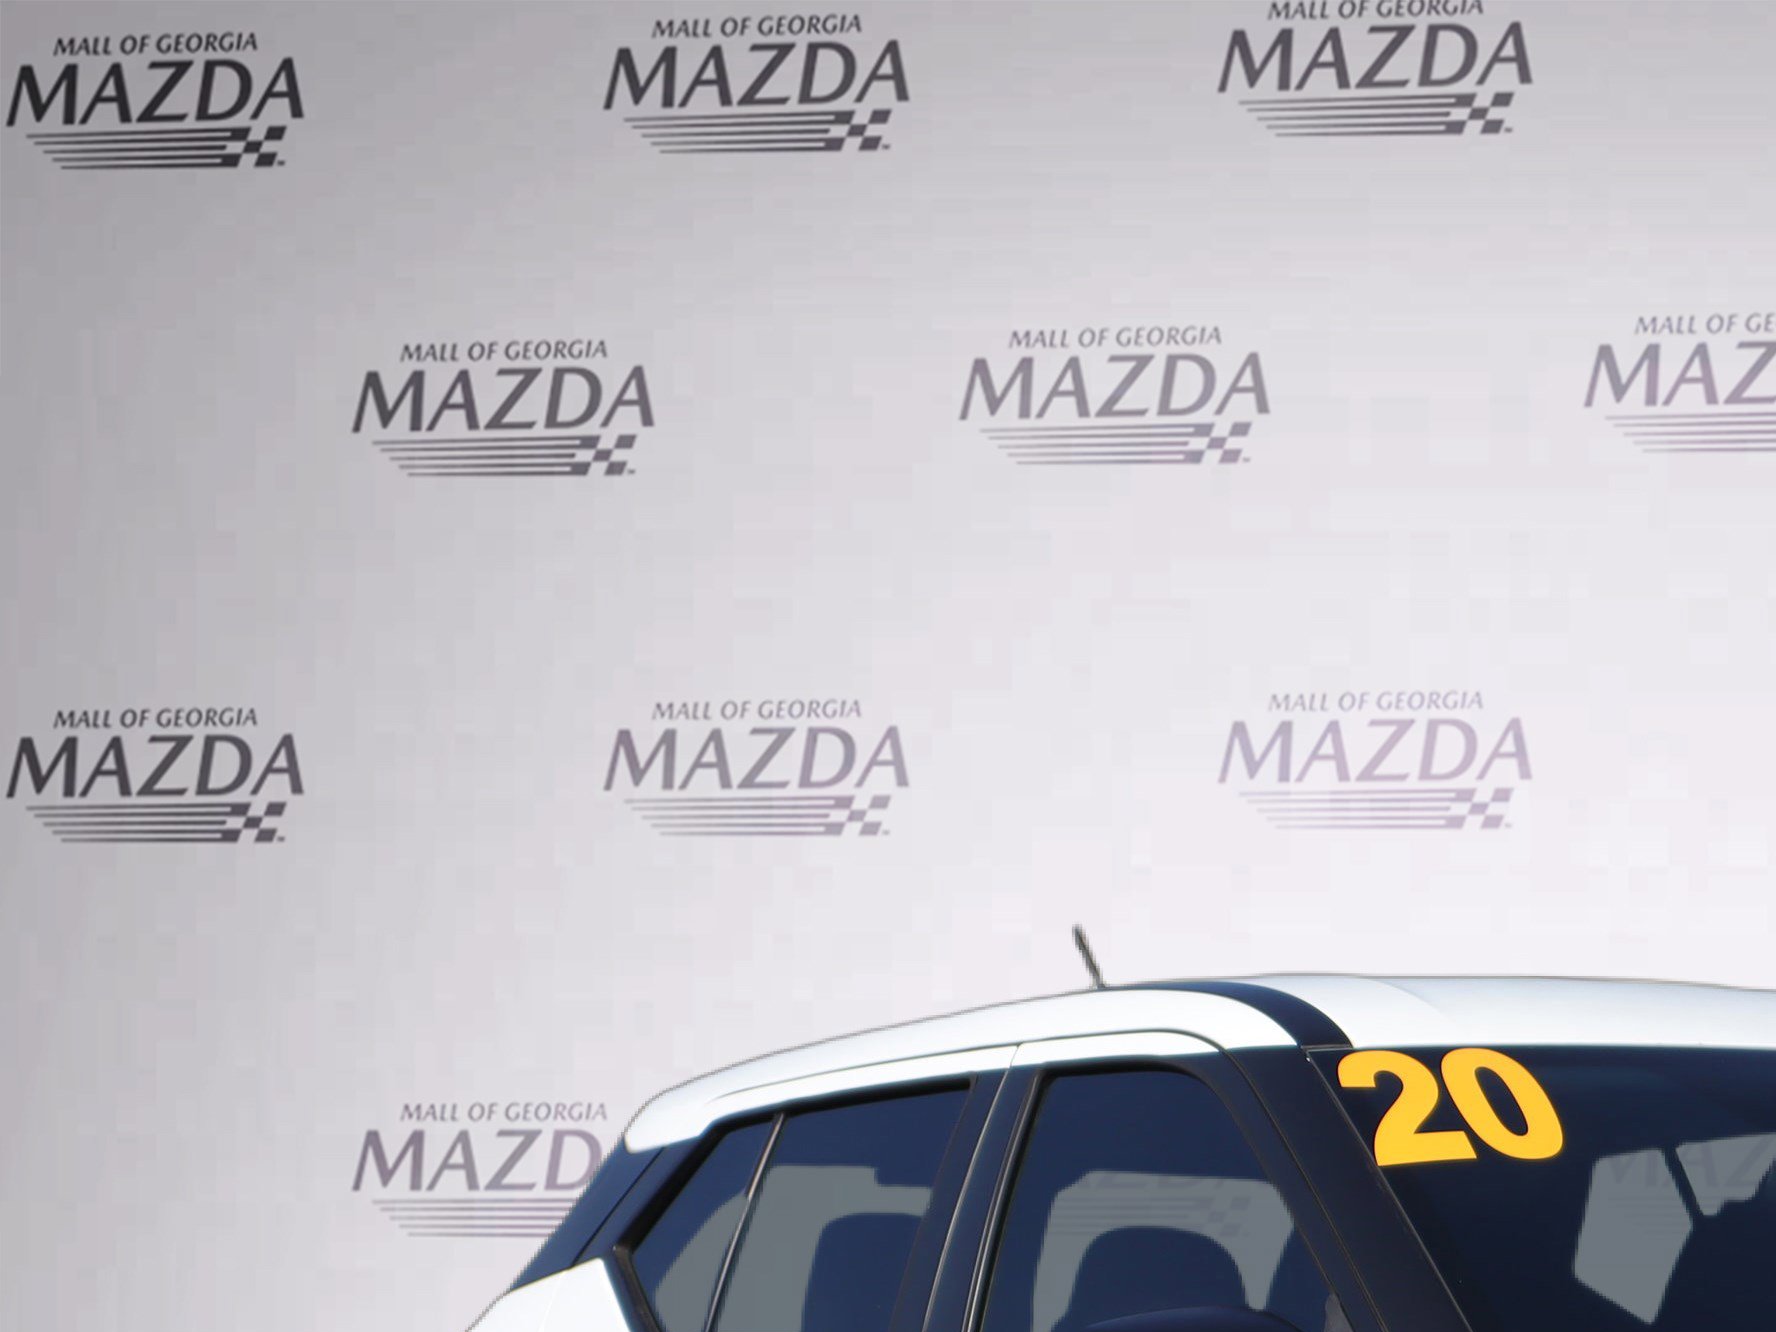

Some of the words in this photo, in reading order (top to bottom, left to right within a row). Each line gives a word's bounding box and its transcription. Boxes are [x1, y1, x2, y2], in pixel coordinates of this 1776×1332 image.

[652, 19, 711, 38] MALL
[720, 17, 751, 37] OF
[757, 14, 862, 36] GEORGIA
[1267, 0, 1329, 20] MALL
[1337, 0, 1370, 19] OF
[1375, 0, 1484, 18] GEORGIA
[53, 36, 111, 56] MALL
[119, 34, 150, 56] OF
[155, 32, 258, 54] GEORGIA
[1217, 21, 1533, 94] MAZDA
[5, 57, 305, 128] MAZDA
[603, 40, 910, 111] MAZDA
[1009, 329, 1069, 349] MALL
[1077, 327, 1109, 348] OF
[1115, 326, 1222, 348] GEORGIA
[1635, 315, 1696, 335] MALL
[1705, 313, 1738, 335] OF
[399, 343, 458, 362] MALL
[467, 341, 498, 362] OF
[503, 340, 608, 361] GEORGIA
[351, 365, 655, 434] MAZDA
[958, 352, 1271, 421] MAZDA
[53, 709, 111, 729] MALL
[119, 708, 150, 729] OF
[155, 708, 258, 729] GEORGIA
[652, 701, 711, 721] MALL
[720, 700, 751, 721] OF
[757, 699, 862, 720] GEORGIA
[1267, 692, 1329, 713] MALL
[1337, 691, 1370, 712] OF
[1375, 691, 1484, 711] GEORGIA
[5, 733, 305, 799] MAZDA
[603, 726, 910, 792] MAZDA
[1217, 717, 1533, 785] MAZDA
[399, 1103, 458, 1122] MALL
[467, 1102, 498, 1122] OF
[503, 1102, 608, 1122] GEORGIA
[1337, 1047, 1564, 1167] 20
[351, 1129, 603, 1193] MAZD
